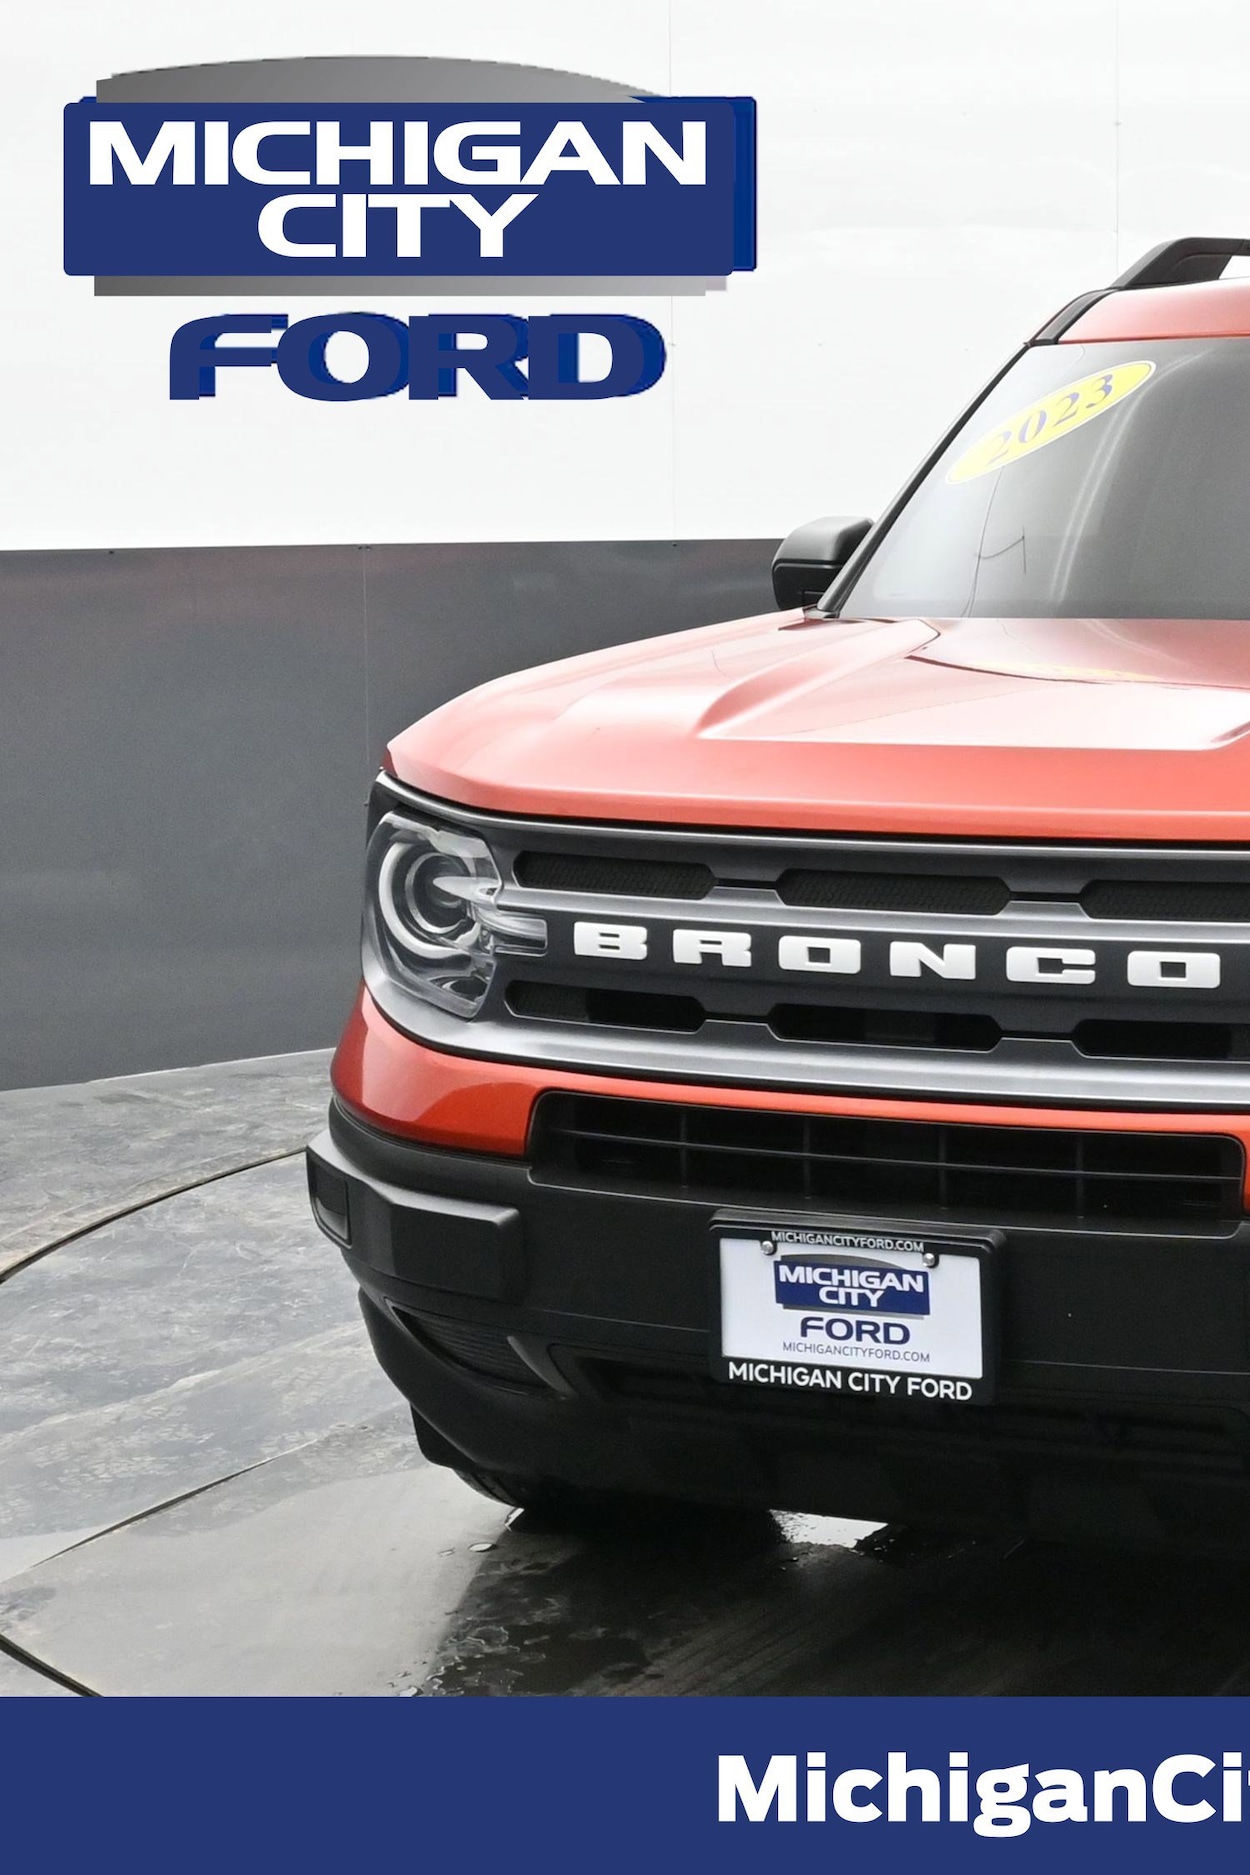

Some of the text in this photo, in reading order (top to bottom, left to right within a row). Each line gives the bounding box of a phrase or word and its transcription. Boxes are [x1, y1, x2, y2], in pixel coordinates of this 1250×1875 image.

[987, 373, 1114, 465] 2023
[573, 920, 1221, 989] BRONCO
[771, 1231, 924, 1253] MICHIGANCITYFORD.COM
[779, 1265, 924, 1293] MICHIGAN
[819, 1287, 884, 1307] CITY
[800, 1316, 910, 1345] FORD
[782, 1341, 930, 1363] MICHIGANCITYFORD.COM
[728, 1361, 973, 1401] MICHIGAN CITY FORD
